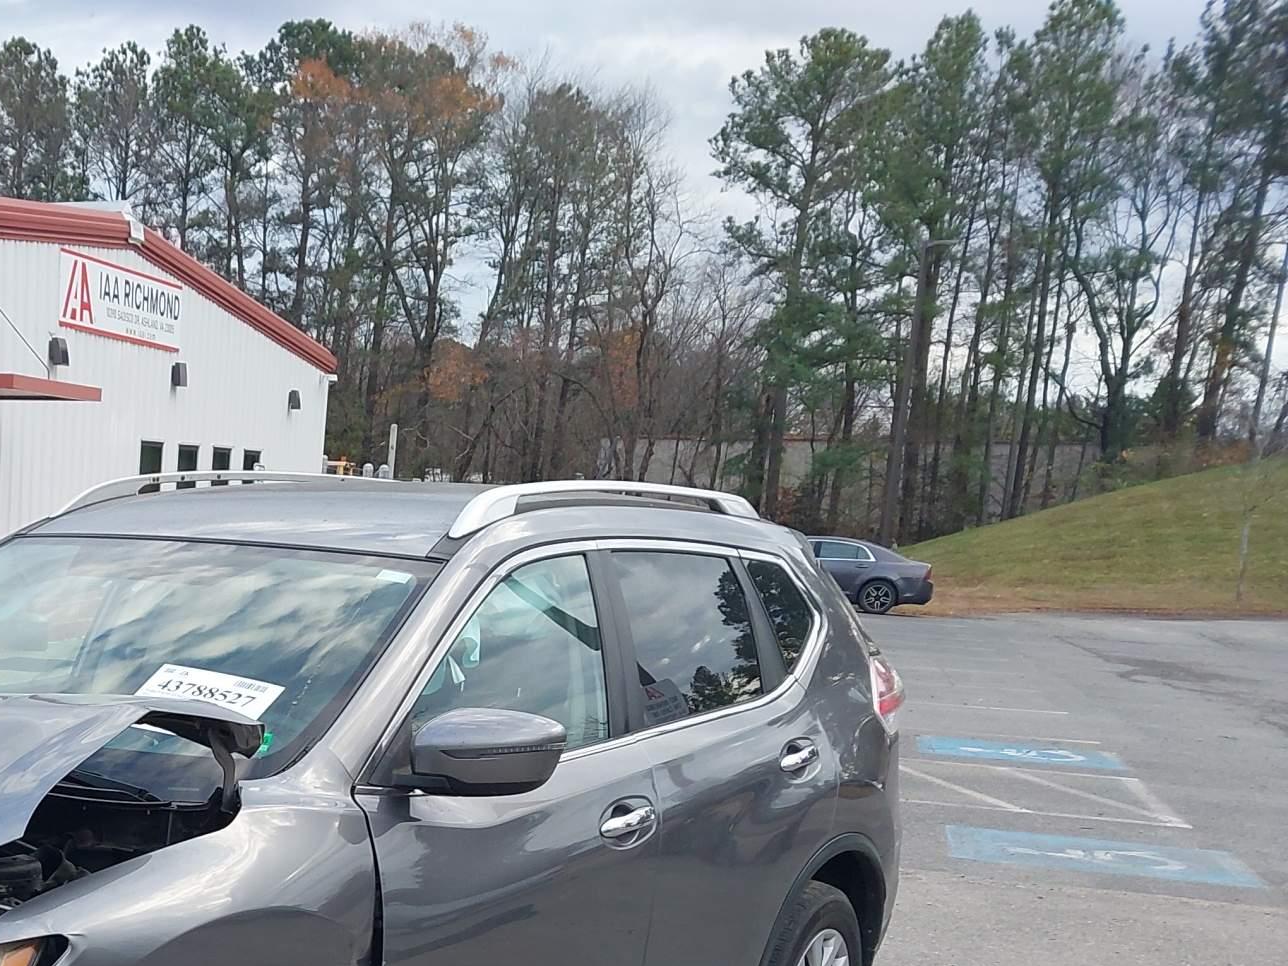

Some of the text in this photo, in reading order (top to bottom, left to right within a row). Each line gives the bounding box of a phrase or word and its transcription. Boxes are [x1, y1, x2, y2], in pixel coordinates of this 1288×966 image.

[99, 271, 181, 321] IAA RICHMOND
[157, 678, 257, 708] 43788527
